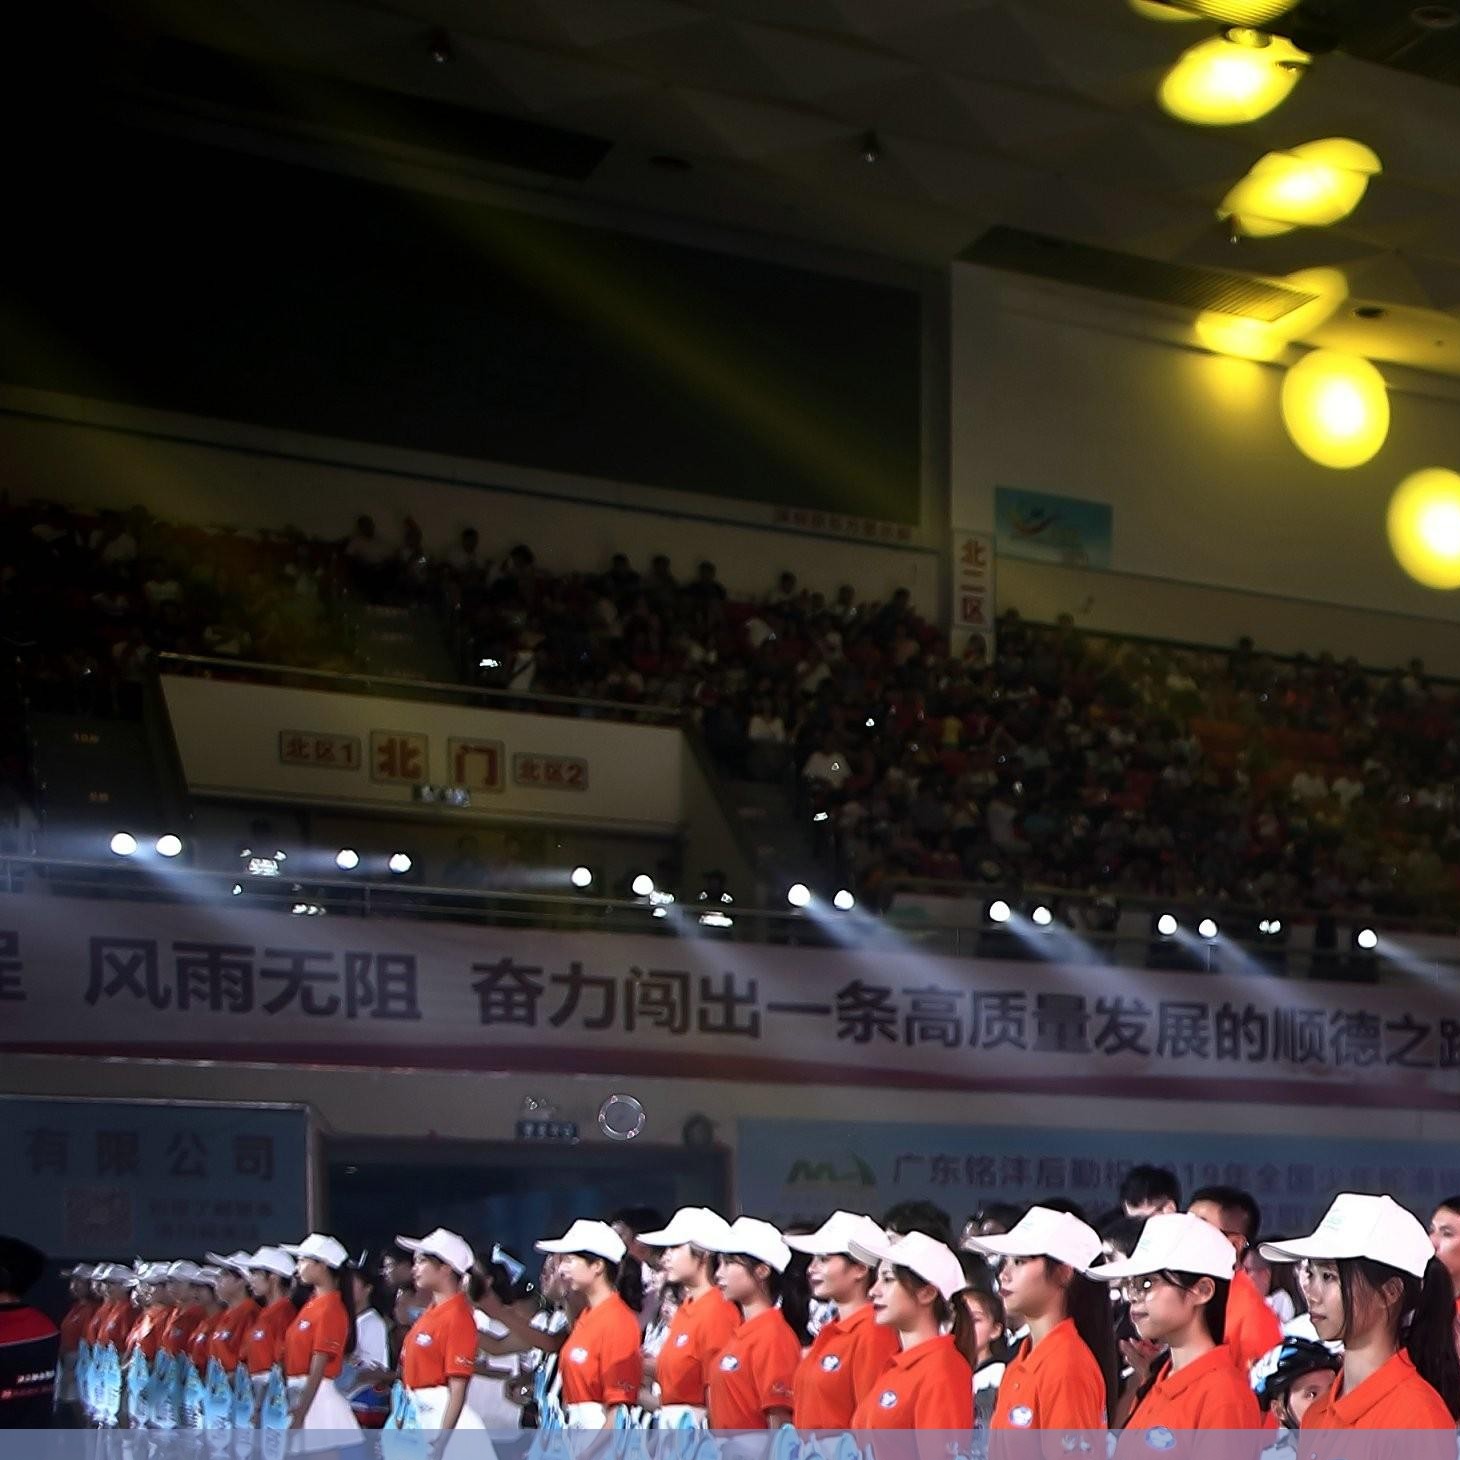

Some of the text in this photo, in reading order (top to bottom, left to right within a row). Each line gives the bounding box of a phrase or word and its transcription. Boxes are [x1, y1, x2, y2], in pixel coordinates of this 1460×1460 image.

[84, 936, 422, 1020] 风雨无阻
[25, 1126, 275, 1182] 有限公司
